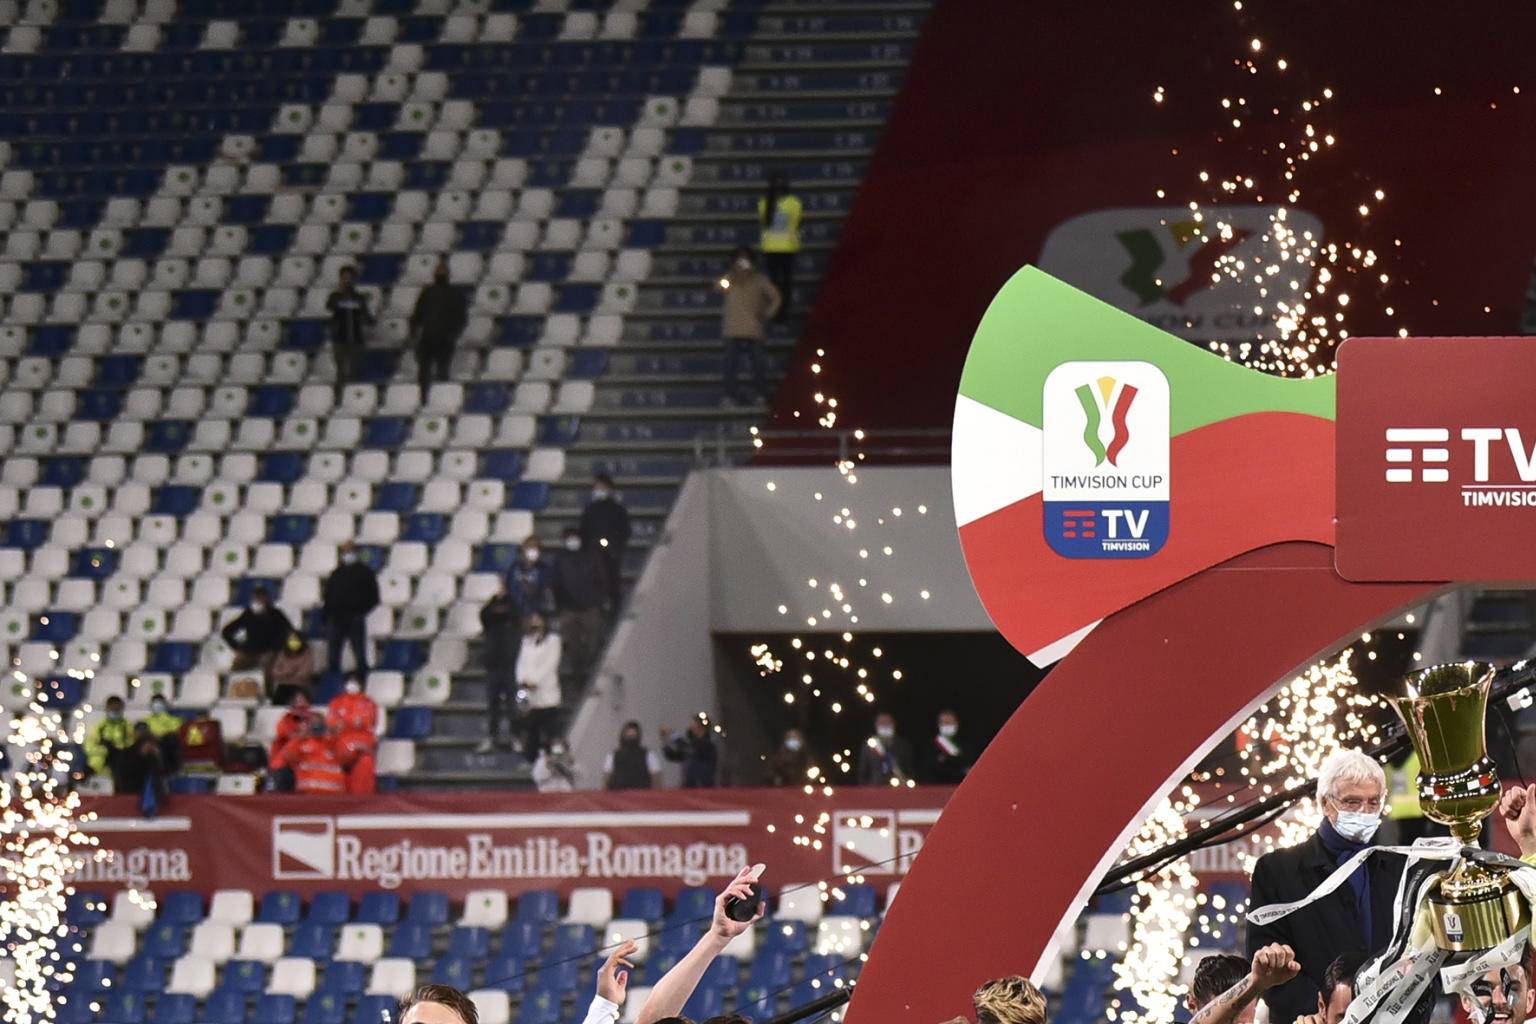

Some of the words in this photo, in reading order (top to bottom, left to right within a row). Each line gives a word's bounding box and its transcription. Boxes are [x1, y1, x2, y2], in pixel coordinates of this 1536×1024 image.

[1051, 475, 1127, 489] TIMVISION
[1132, 475, 1162, 489] CUP
[1101, 510, 1149, 538] TV
[1101, 541, 1150, 551] TIMVISION
